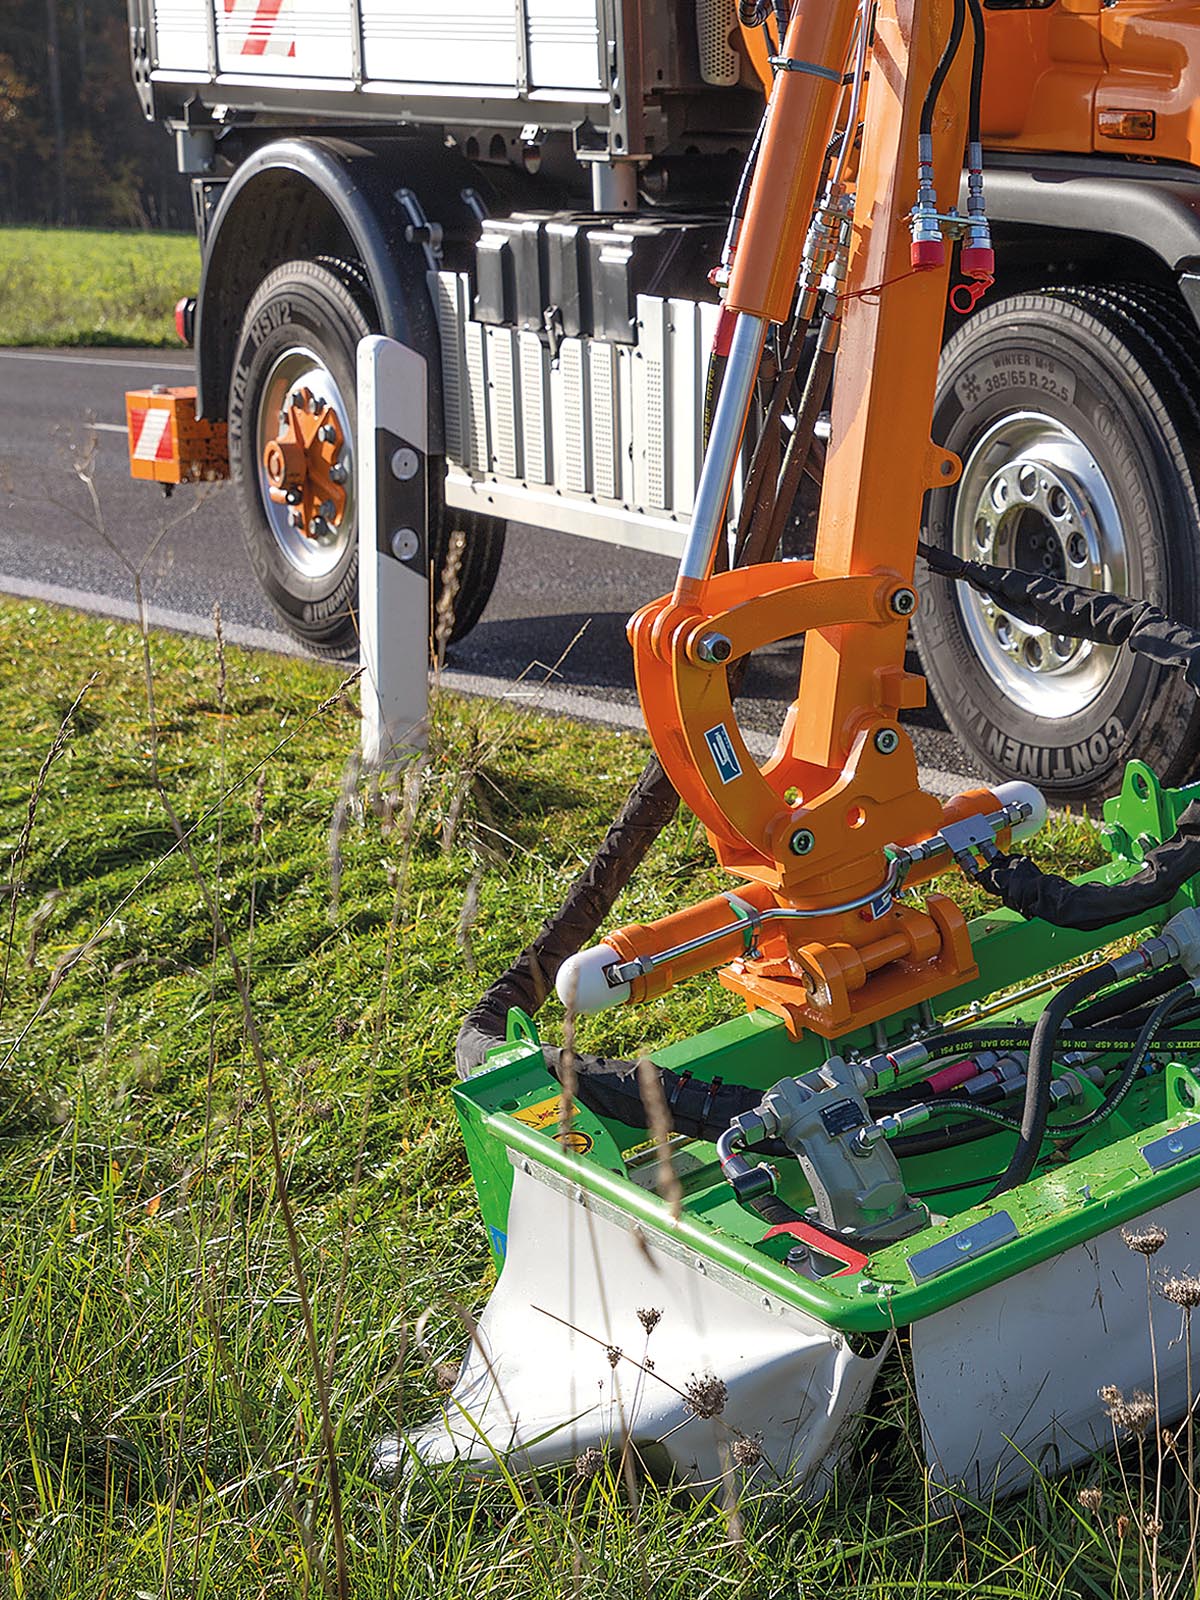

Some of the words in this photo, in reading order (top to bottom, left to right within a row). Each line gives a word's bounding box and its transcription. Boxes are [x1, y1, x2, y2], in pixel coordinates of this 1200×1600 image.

[992, 354, 1031, 369] WINTER
[984, 369, 1027, 393] 385/65
[1029, 372, 1038, 387] R
[1041, 376, 1069, 402] 22.5
[955, 680, 1125, 779] CONTINENTAL
[980, 1040, 998, 1048] BAR
[1016, 1039, 1030, 1047] WP
[1074, 1040, 1087, 1048] DN
[1095, 1039, 1111, 1049] 4SP
